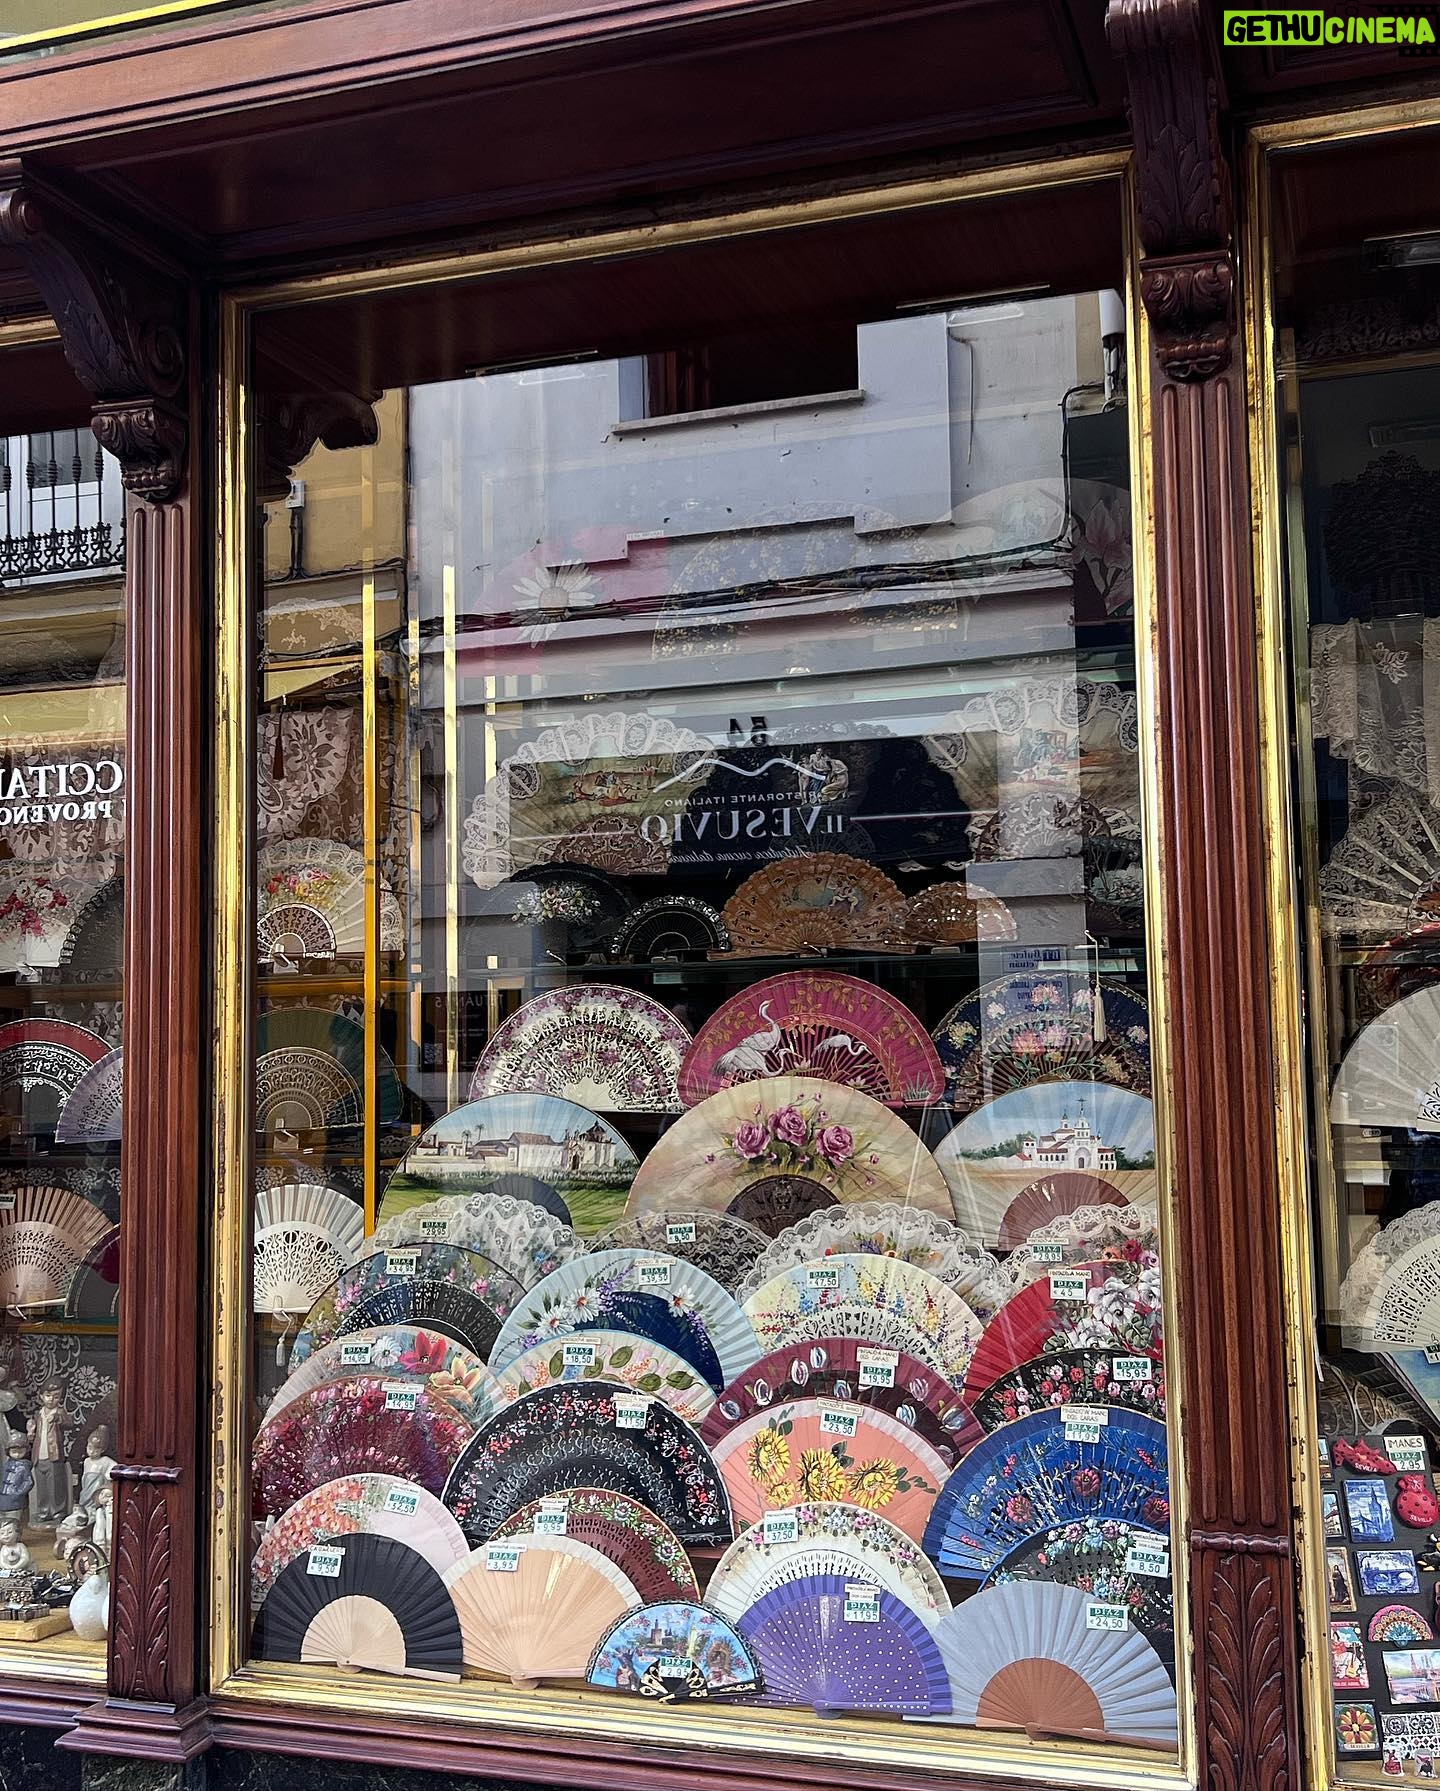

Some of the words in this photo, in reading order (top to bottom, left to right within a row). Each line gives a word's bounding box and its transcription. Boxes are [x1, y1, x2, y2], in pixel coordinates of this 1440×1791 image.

[571, 1356, 591, 1364] 18,50
[1122, 1369, 1147, 1379] 15,95
[829, 1423, 853, 1435] 23,50
[1355, 1463, 1377, 1472] SEVILLA
[543, 1523, 561, 1532] 9,95
[772, 1530, 793, 1541] 37,50
[1139, 1562, 1161, 1573] 8,50
[1095, 1617, 1123, 1628] 24,50
